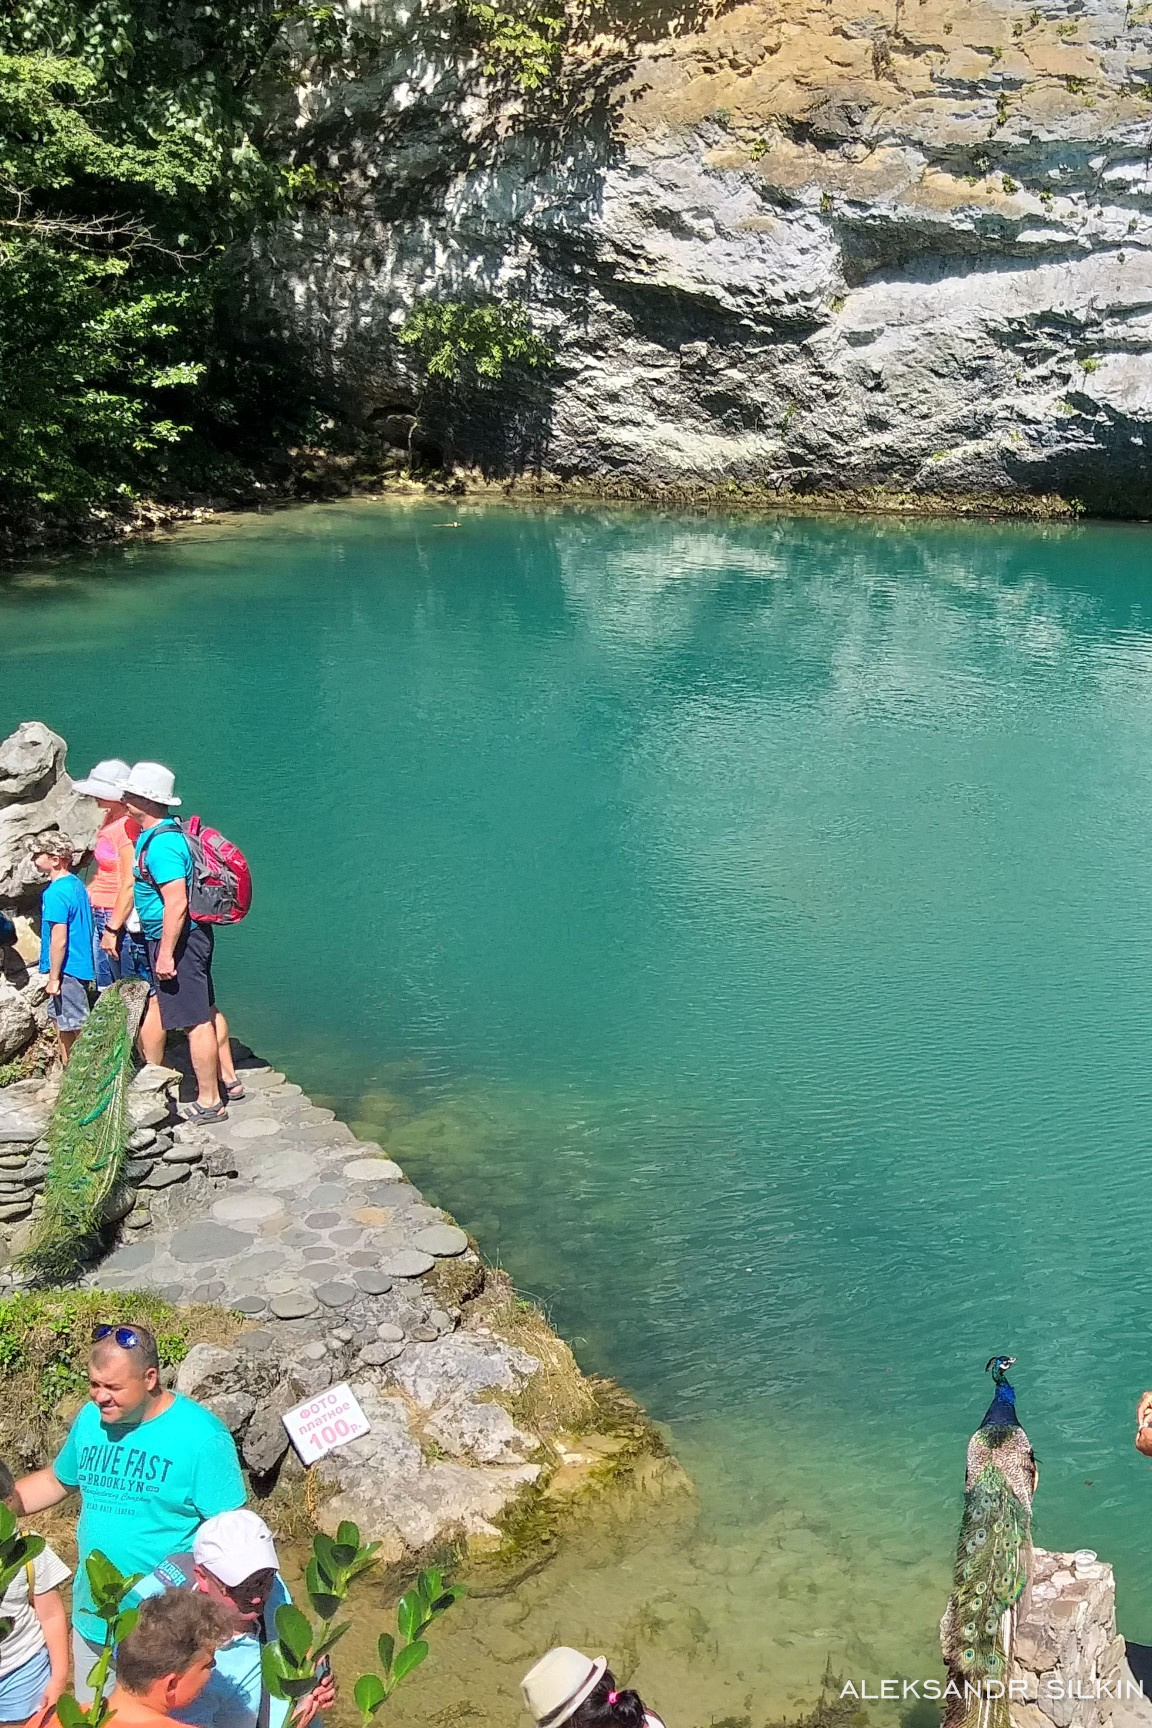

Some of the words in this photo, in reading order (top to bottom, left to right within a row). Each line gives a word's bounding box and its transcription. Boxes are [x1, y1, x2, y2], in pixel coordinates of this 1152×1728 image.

[298, 1402, 351, 1435] платное
[299, 1394, 337, 1419] ФОТО
[78, 1445, 125, 1476] DRIVE
[124, 1448, 174, 1483] FAST
[87, 1472, 145, 1494] BROOKLYN
